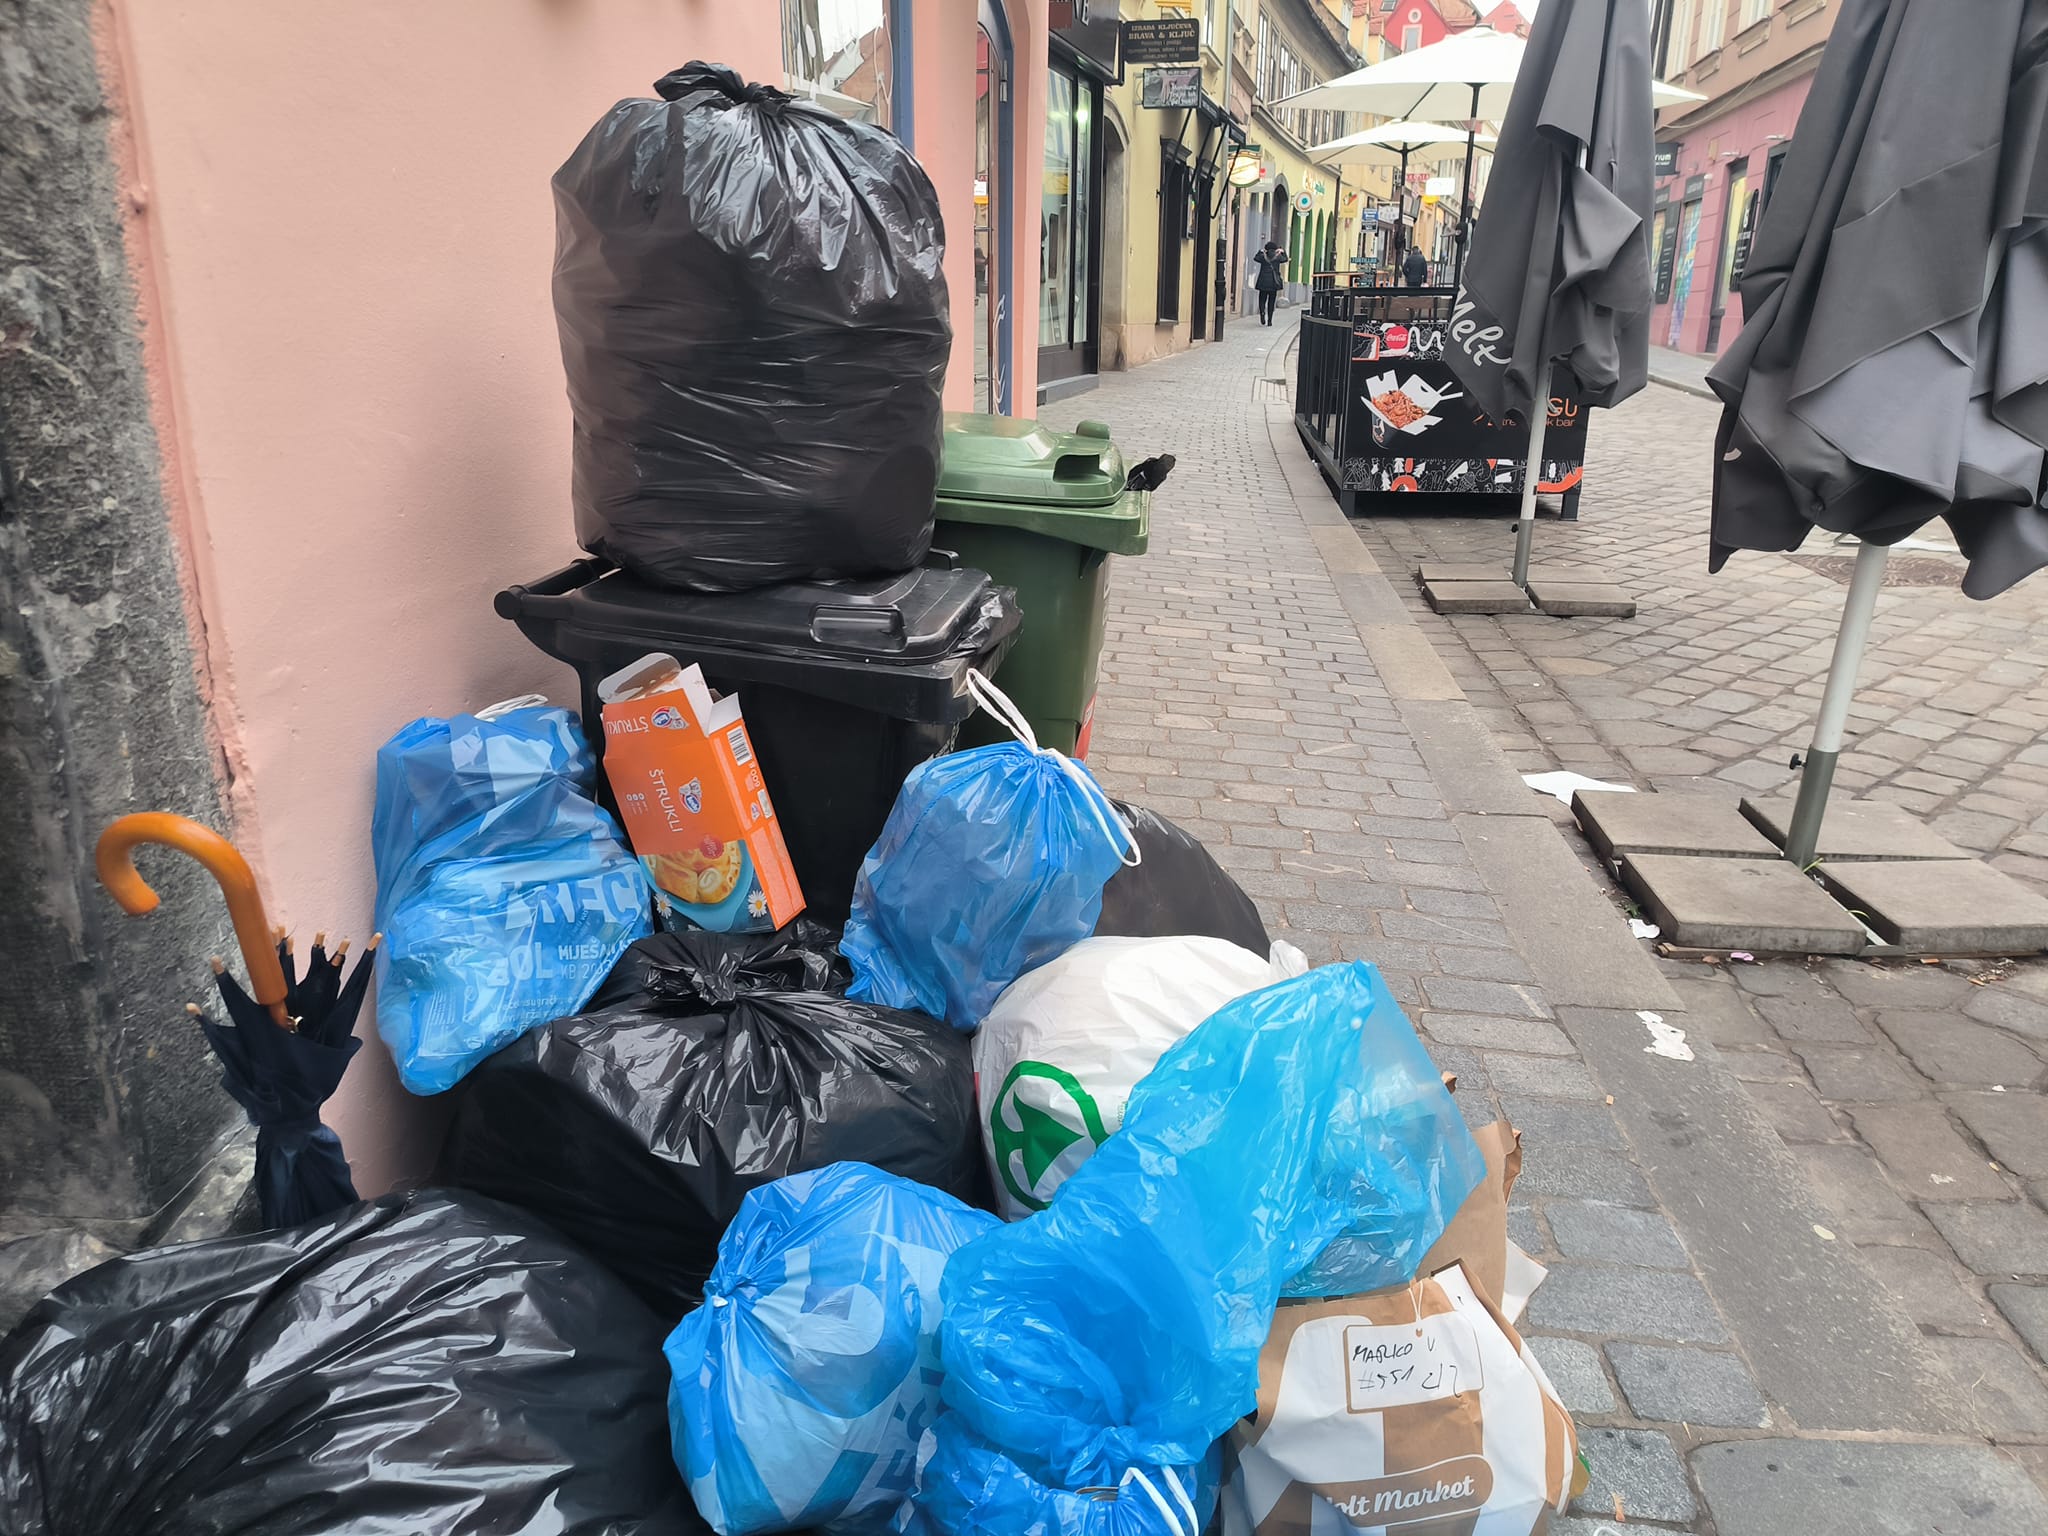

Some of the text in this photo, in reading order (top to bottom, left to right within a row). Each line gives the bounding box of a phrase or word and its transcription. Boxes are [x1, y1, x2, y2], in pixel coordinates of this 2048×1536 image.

[1128, 32, 1154, 40] BRAVA
[1169, 28, 1195, 38] KLJUČ
[1556, 417, 1576, 427] bar
[649, 768, 684, 832] ŠTRUKLI
[1326, 1475, 1475, 1517] olt Market
